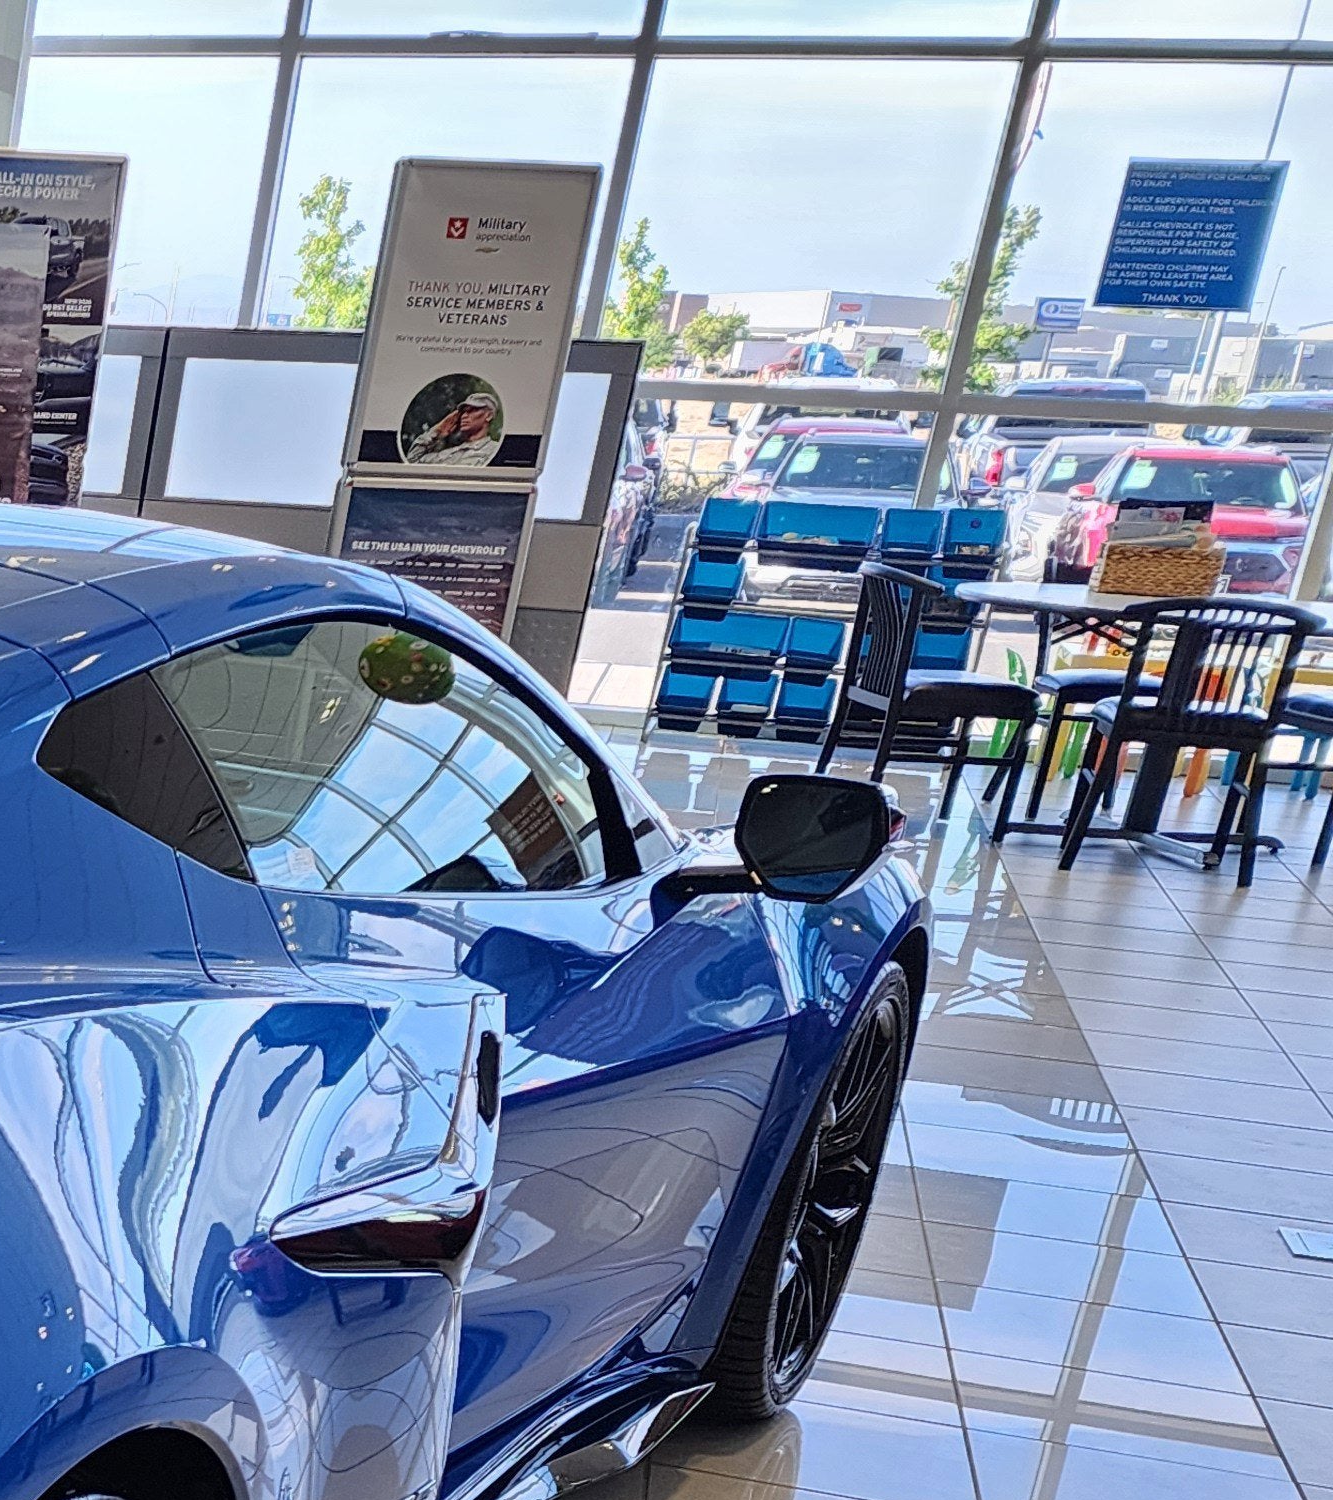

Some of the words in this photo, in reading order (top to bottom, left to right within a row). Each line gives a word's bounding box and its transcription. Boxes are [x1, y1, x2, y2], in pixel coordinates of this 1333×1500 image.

[36, 173, 53, 186] ON
[23, 186, 32, 197] &
[34, 187, 80, 199] POWER
[1126, 196, 1153, 204] ADULT
[1176, 205, 1188, 213] AT
[478, 217, 527, 233] Military
[1153, 221, 1204, 230] CHEVROLET
[1214, 223, 1234, 231] NOT
[476, 233, 531, 242] appreciation
[1175, 230, 1194, 238] FOR
[1195, 231, 1211, 239] THE
[1186, 240, 1219, 248] SAFETY
[1113, 246, 1154, 254] CHILDREN
[1156, 247, 1177, 255] LEFT
[1109, 262, 1164, 271] UNATTENDED
[1166, 264, 1209, 272] CHILDREN
[1162, 272, 1190, 280] LEAVE
[408, 281, 450, 293] THANK
[456, 282, 484, 295] YOU,
[487, 283, 550, 296] MILITARY
[1142, 293, 1180, 302] THANK
[406, 296, 462, 309] SERVICE
[466, 298, 531, 311] MEMBERS
[535, 300, 544, 311] &
[438, 313, 508, 326] VETERANS
[351, 540, 370, 550] SEE
[371, 541, 390, 550] THE
[391, 542, 410, 551] USA
[411, 543, 422, 552] IN
[423, 543, 450, 553] YOUR
[451, 544, 507, 556] CHEVROLET
